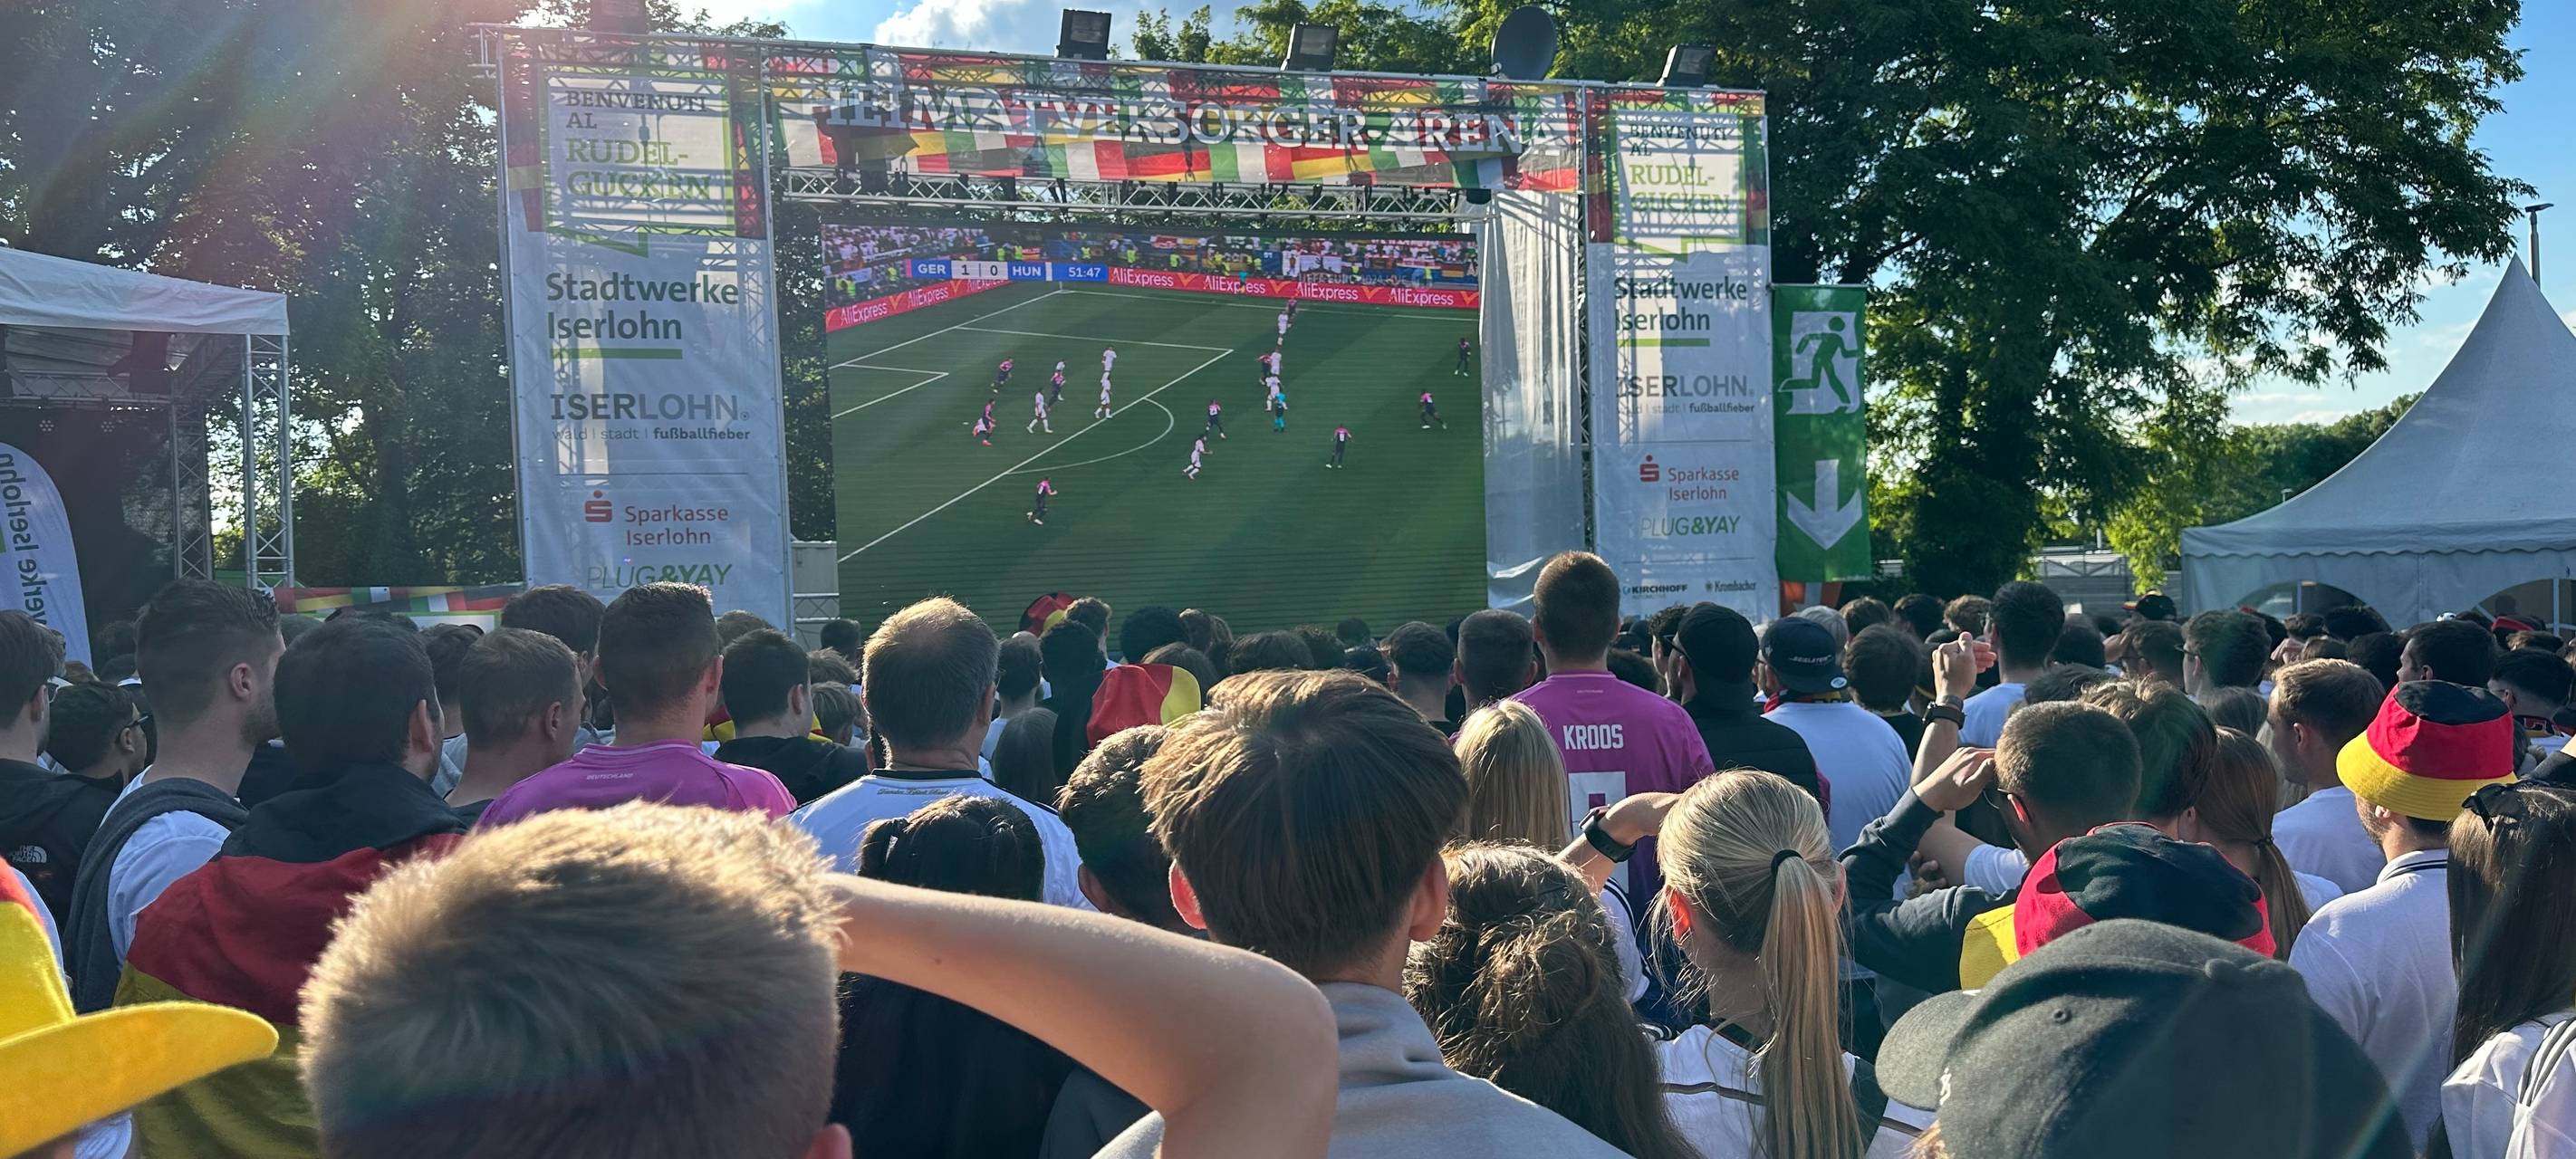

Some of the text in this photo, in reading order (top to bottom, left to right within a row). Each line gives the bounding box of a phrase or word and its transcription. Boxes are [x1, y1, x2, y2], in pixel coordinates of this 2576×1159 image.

[565, 91, 706, 111] BENVENUTI
[565, 113, 597, 129] AL
[565, 139, 688, 166] RUDEL-
[1630, 144, 1651, 157] AL
[567, 171, 710, 200] GUCKEN
[1630, 165, 1715, 187] RUDEL-
[918, 263, 947, 274] GER
[961, 264, 998, 276] 1 0
[1013, 265, 1042, 277] HUN
[1069, 267, 1101, 278] 51:47
[1112, 268, 1174, 288] AliExpress
[546, 273, 738, 304] Stadtwerke
[908, 287, 949, 309] AliExpress
[1296, 283, 1359, 301] AliExpress
[1389, 288, 1454, 306] AliExpress
[1614, 276, 1747, 301] Stadtwerke
[841, 304, 888, 325] AliExpress
[1616, 307, 1710, 330] Iserlohn
[548, 311, 682, 340] Iserlohn
[553, 427, 751, 441] wald stadt fußballfieber
[1668, 467, 1739, 484] Sparkasse
[1669, 486, 1726, 501] Iserlohn
[625, 505, 728, 525] Sparkasse
[1640, 516, 1741, 536] PLUG&YAY
[627, 529, 710, 545] Iserlohn
[585, 563, 732, 589] PLUG&YAY
[1563, 724, 1623, 751] KROOS
